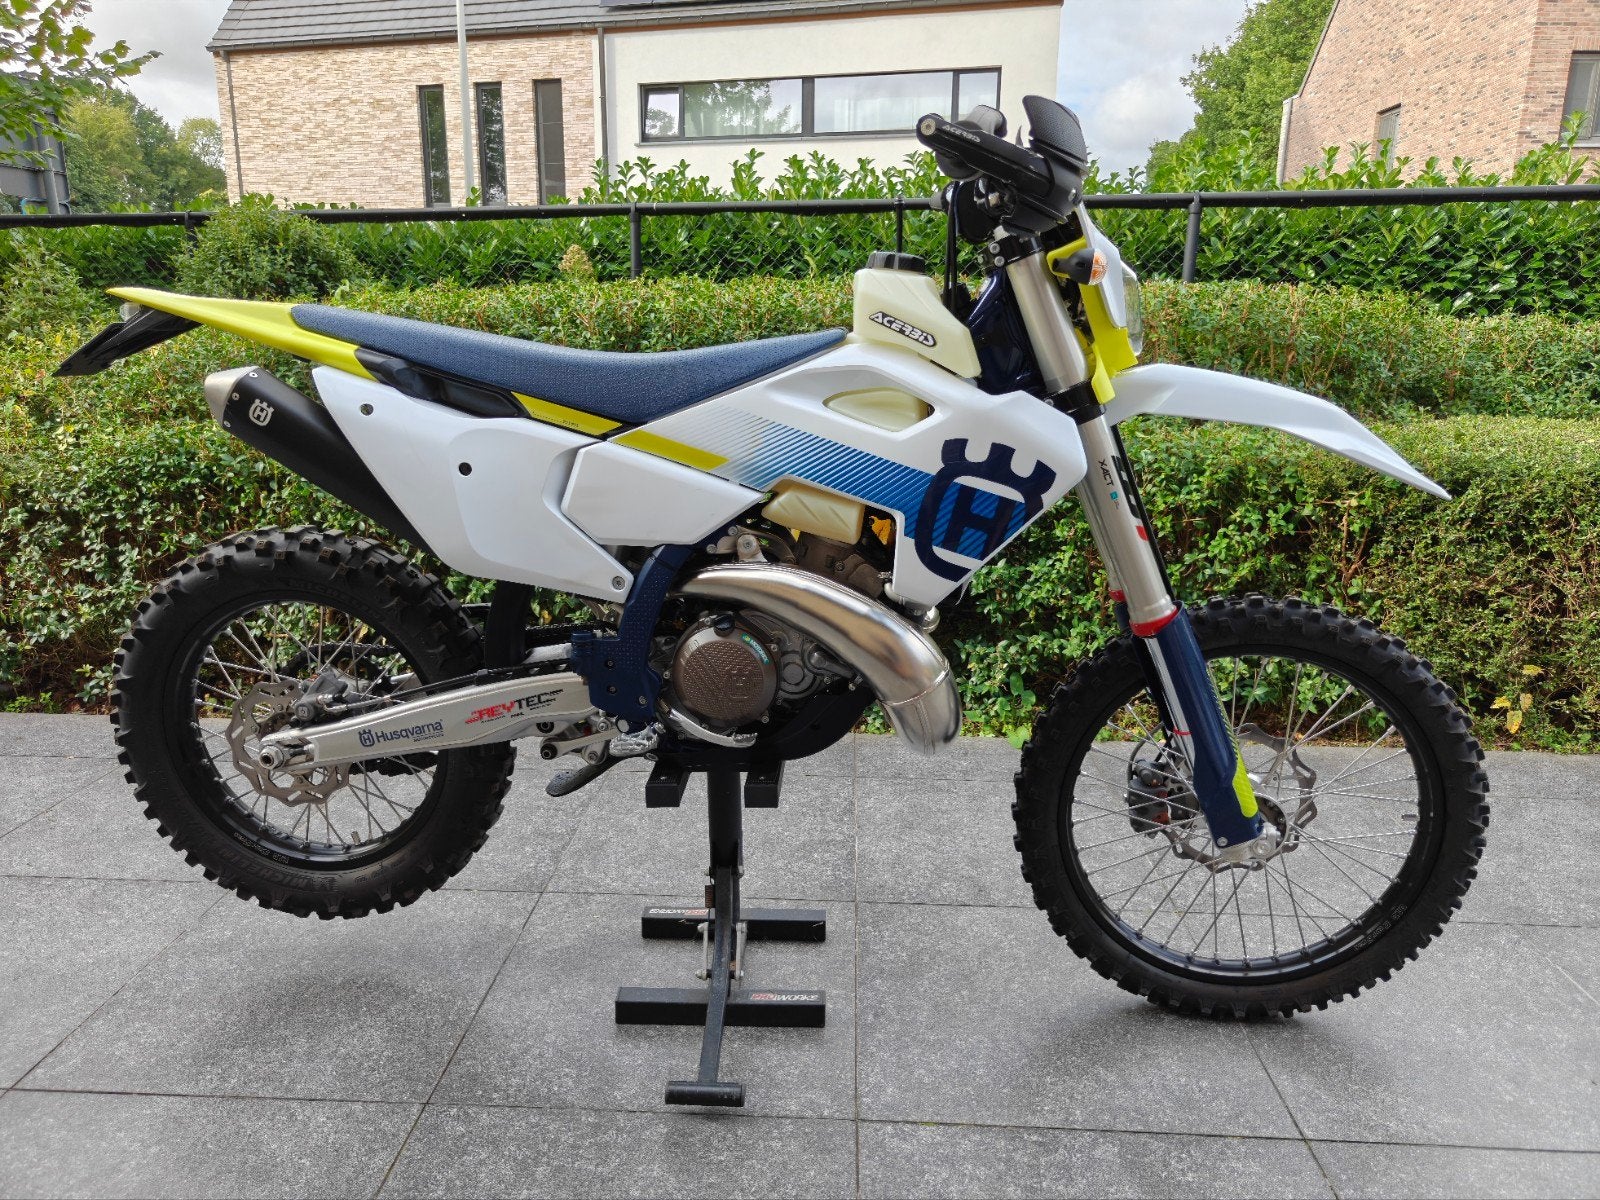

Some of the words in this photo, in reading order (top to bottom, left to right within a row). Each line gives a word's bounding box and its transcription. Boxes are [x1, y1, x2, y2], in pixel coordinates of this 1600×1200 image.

[869, 311, 937, 347] ACERBIS
[1097, 458, 1115, 487] XACT
[375, 720, 443, 742] Husqvarna
